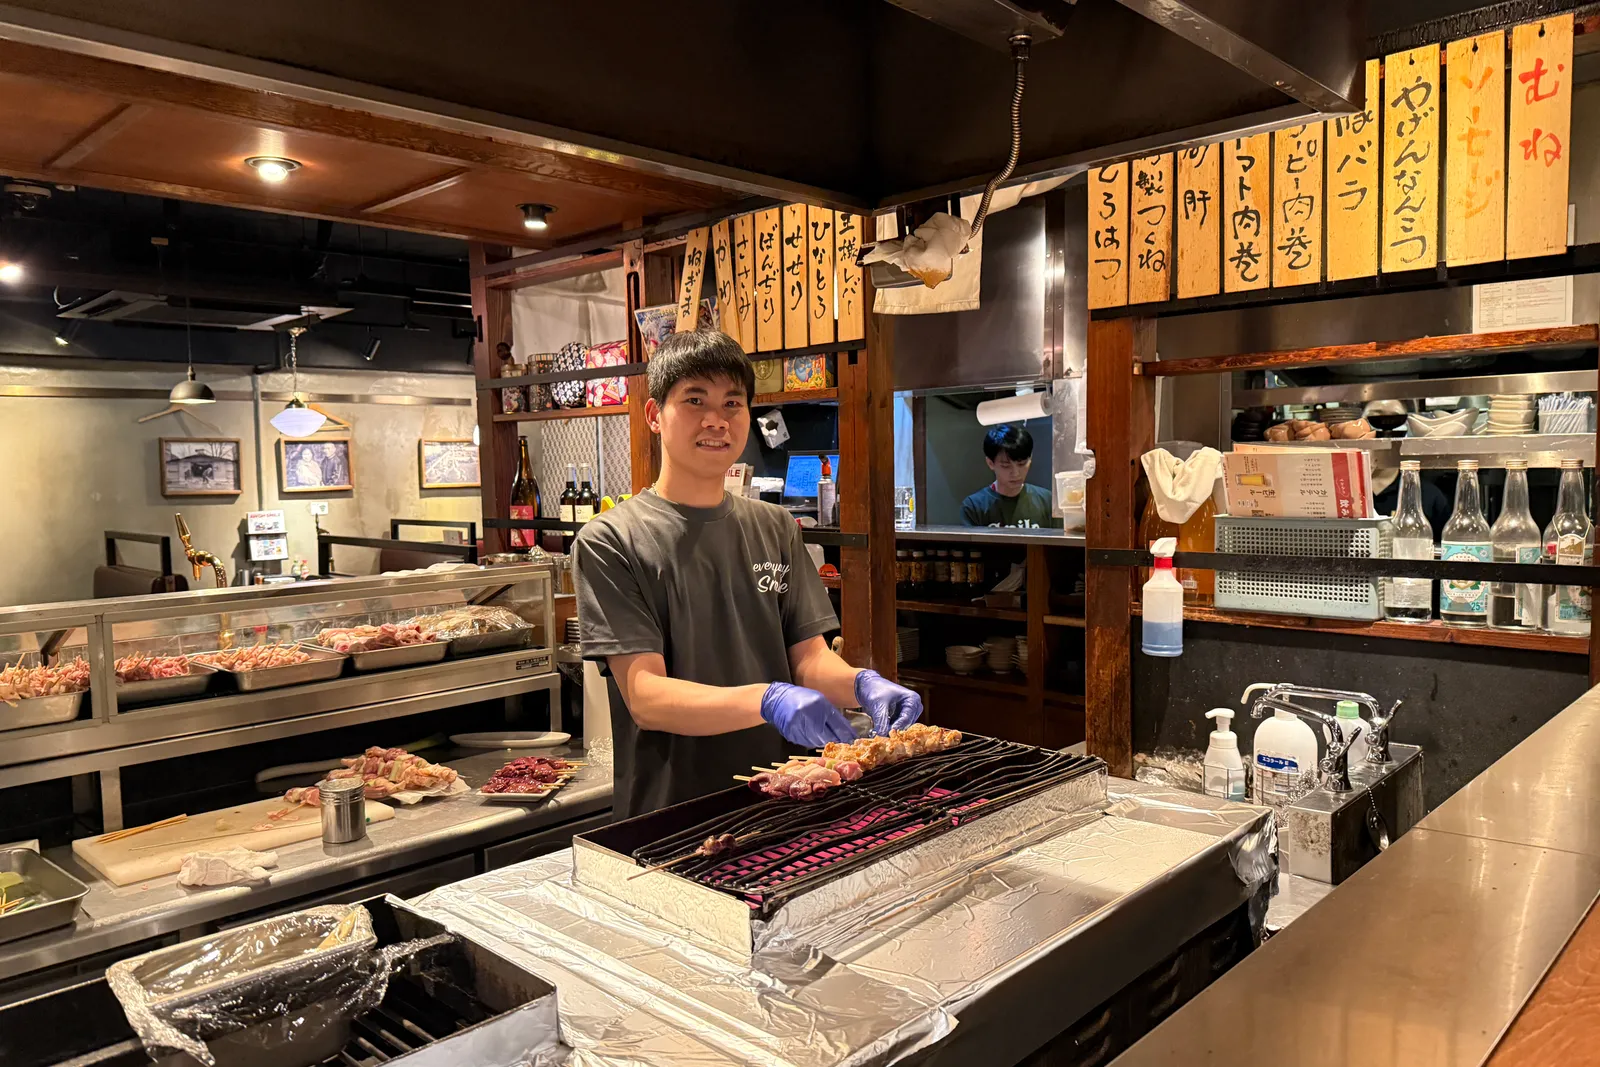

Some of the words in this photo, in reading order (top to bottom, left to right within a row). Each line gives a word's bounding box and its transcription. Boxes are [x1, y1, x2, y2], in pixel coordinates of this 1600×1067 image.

[1457, 66, 1501, 219] ソーセージ
[1518, 57, 1565, 167] むね
[1135, 155, 1167, 273] 製つくね
[1390, 75, 1435, 264] やげんなんこつ
[680, 247, 703, 318] ねぎま
[715, 239, 732, 306] かわ
[736, 233, 751, 322] ささみ
[784, 224, 804, 311] せせり
[811, 221, 831, 320] ひなとろ
[1339, 499, 1350, 518] 飲み
